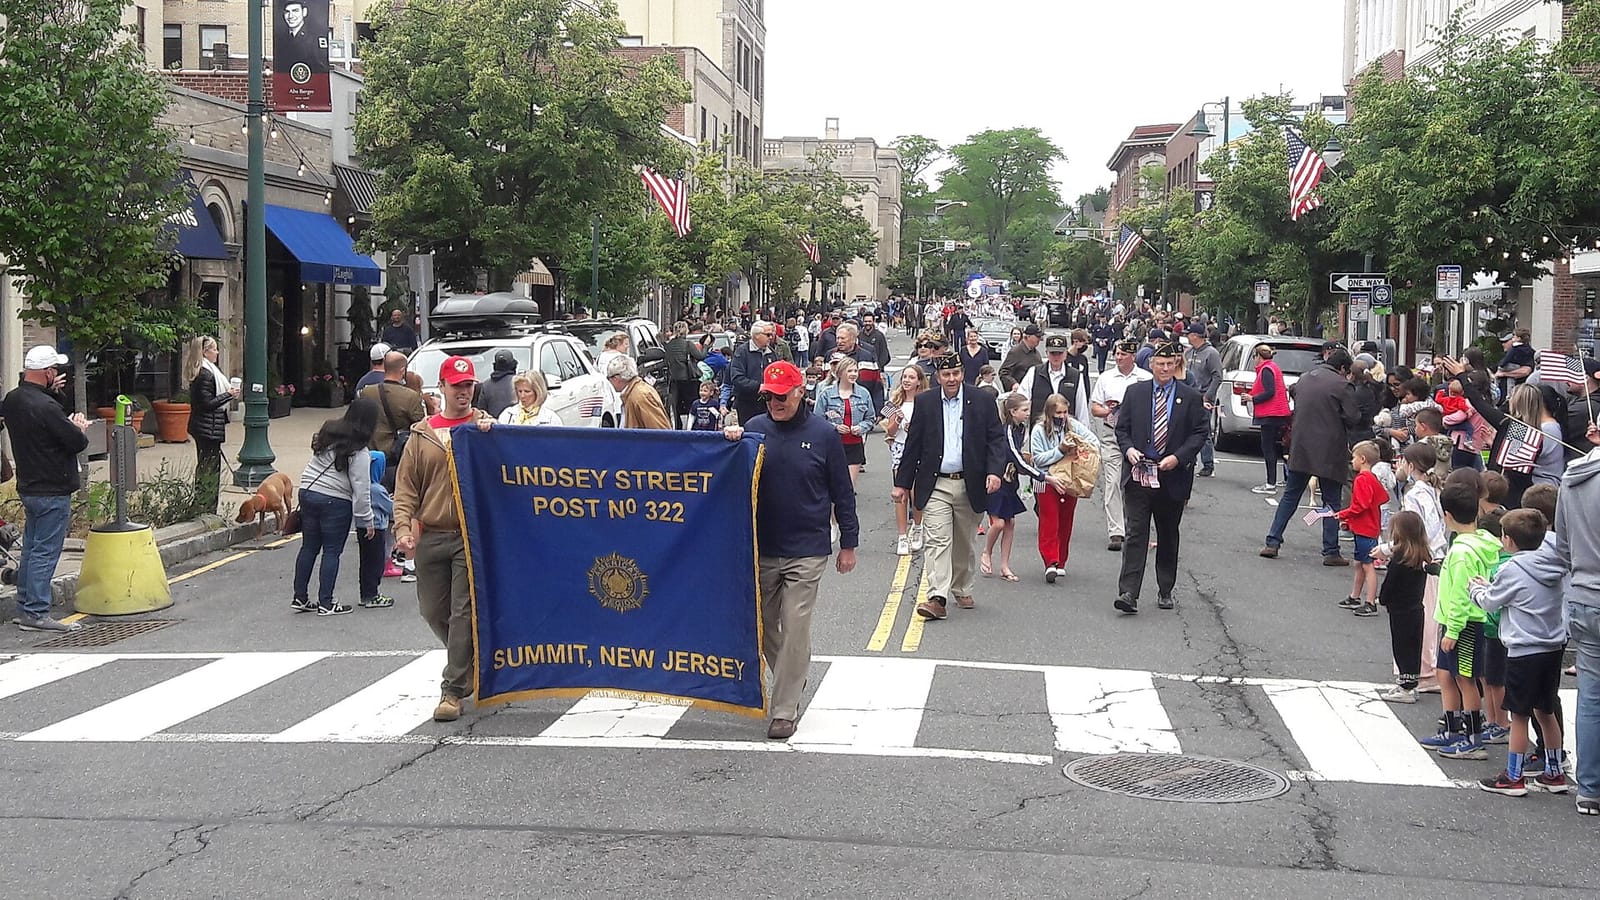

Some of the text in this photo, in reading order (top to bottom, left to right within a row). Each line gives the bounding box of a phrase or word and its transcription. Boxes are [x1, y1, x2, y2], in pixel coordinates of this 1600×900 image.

[971, 287, 978, 295] S
[1347, 279, 1383, 287] ONE WAY
[501, 464, 713, 493] LINDSEY STREET
[532, 496, 600, 518] POST
[645, 500, 685, 523] 322
[493, 643, 745, 681] SUMMIT, NEW JERSEY
